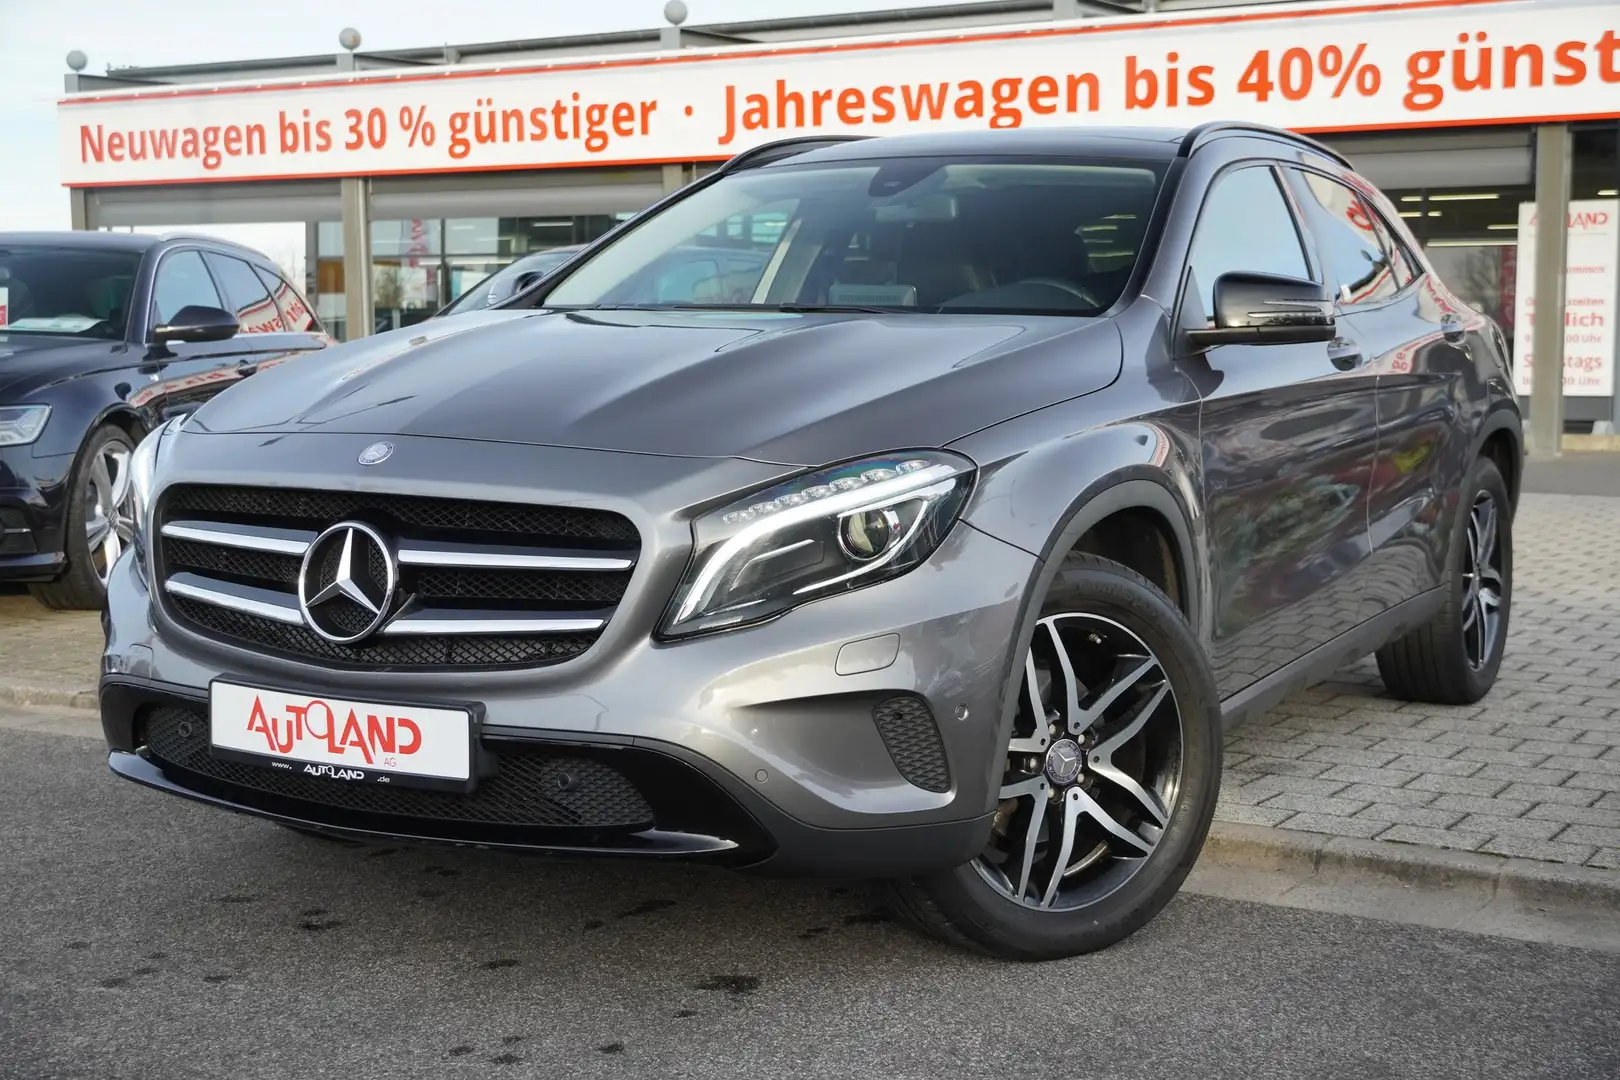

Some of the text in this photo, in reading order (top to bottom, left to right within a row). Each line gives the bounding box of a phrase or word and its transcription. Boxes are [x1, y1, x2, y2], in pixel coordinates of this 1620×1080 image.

[80, 124, 267, 170] Neuwagen
[279, 109, 332, 153] bis
[345, 107, 387, 151] 30
[399, 105, 436, 148] %
[447, 92, 657, 160] günstiger
[717, 72, 1100, 145] Jahreswagen
[1125, 51, 1215, 111] bis
[1236, 42, 1382, 103] 40%
[271, 761, 292, 770] www.
[384, 757, 396, 768] AG
